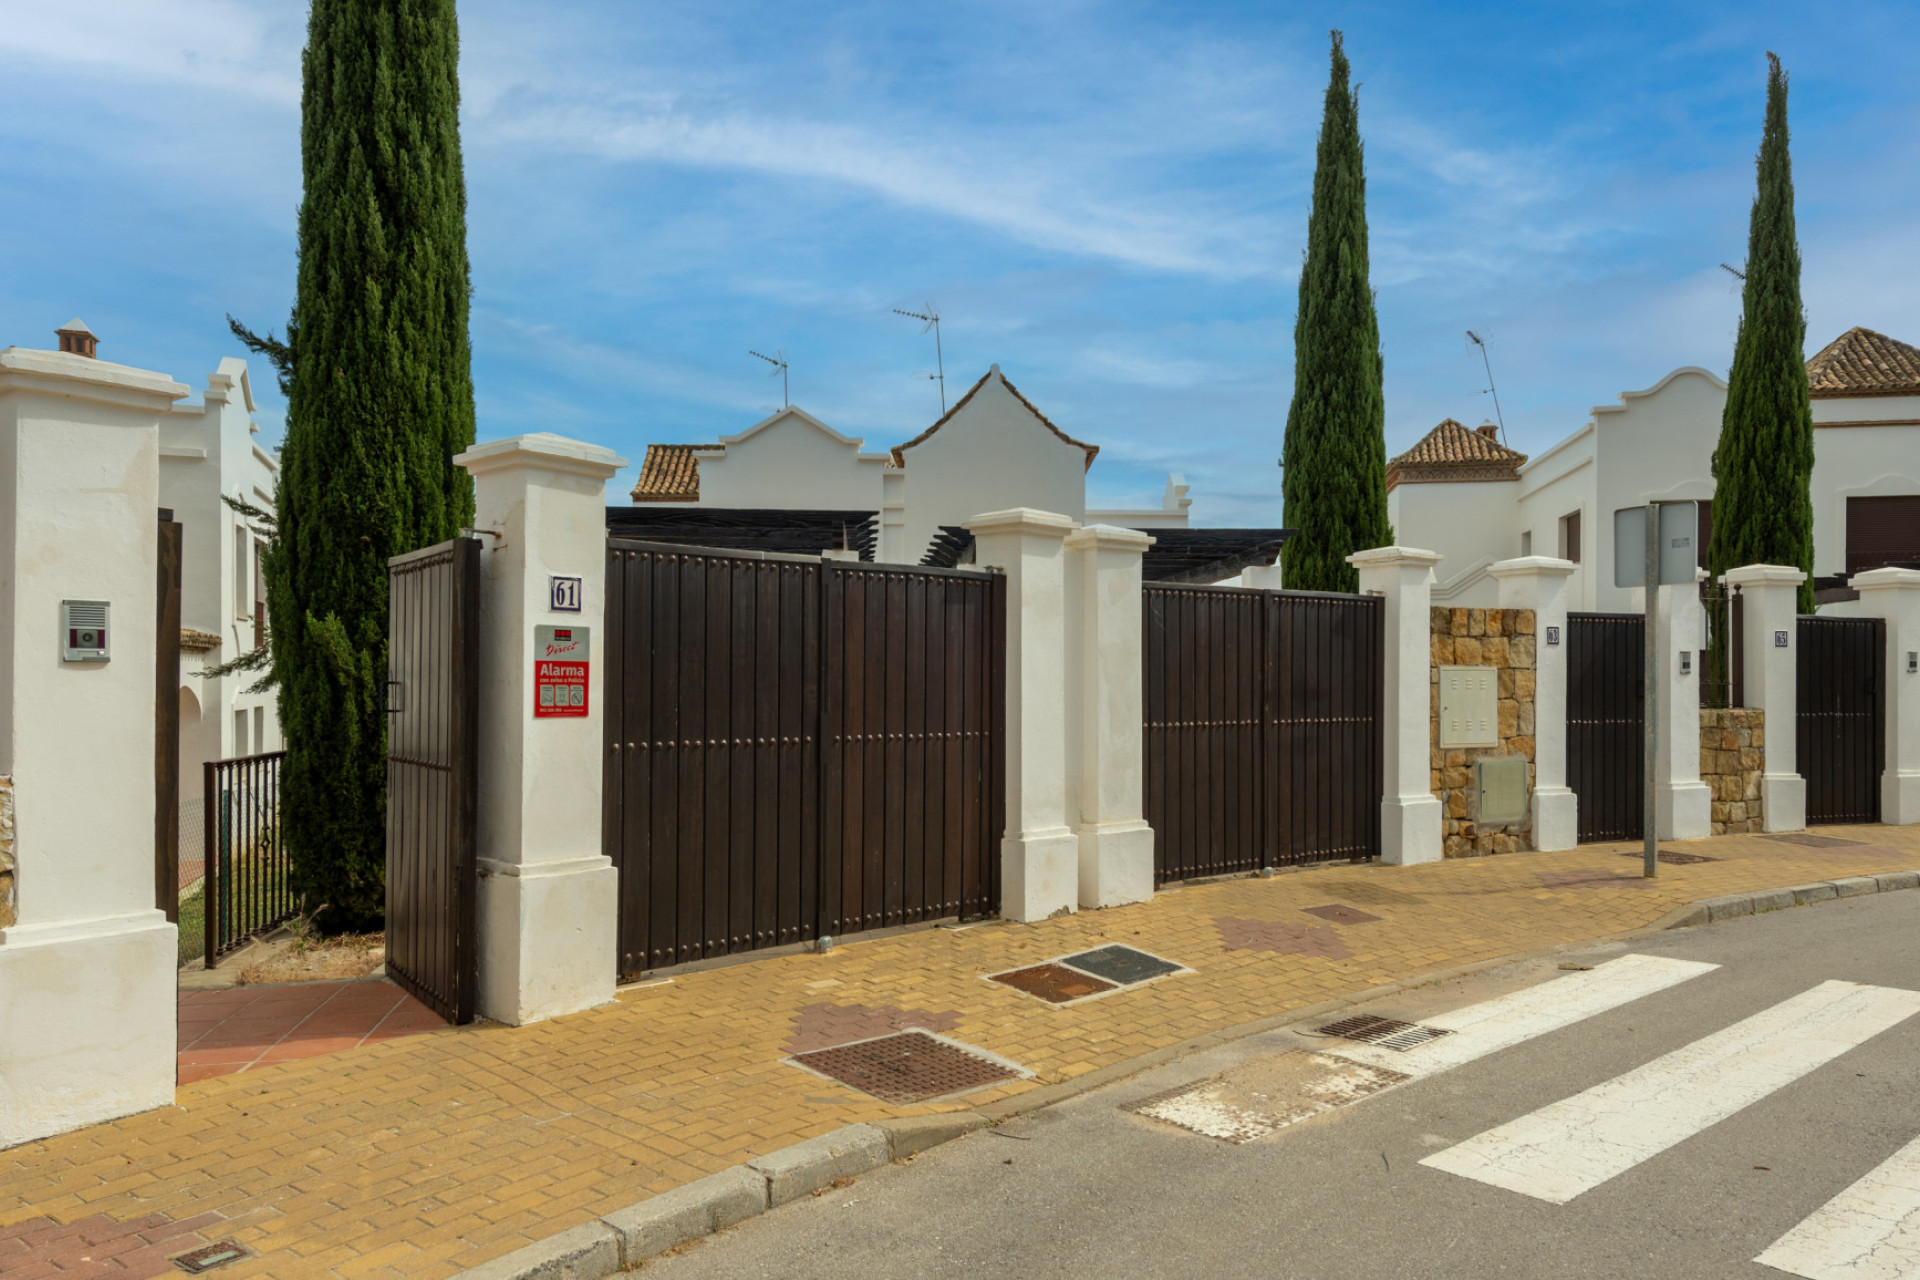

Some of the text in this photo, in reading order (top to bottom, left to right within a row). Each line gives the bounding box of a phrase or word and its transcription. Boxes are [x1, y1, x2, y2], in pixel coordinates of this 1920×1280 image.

[556, 581, 575, 607] 61
[545, 641, 580, 657] Direct
[540, 663, 584, 676] Alarma
